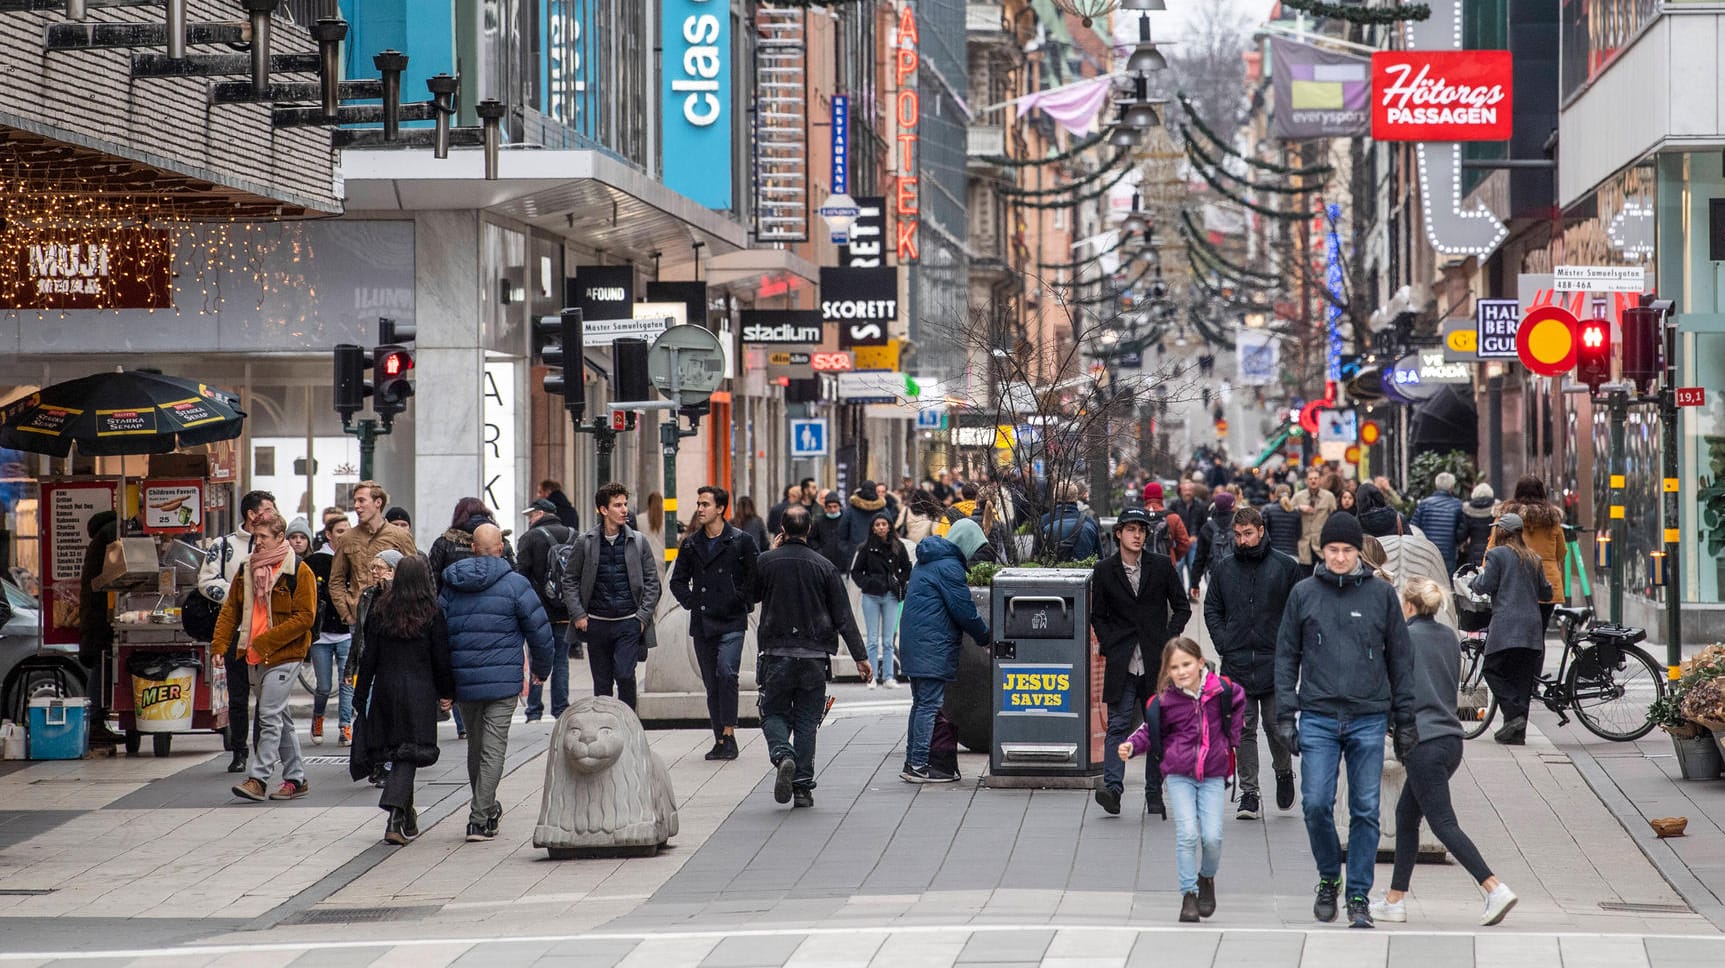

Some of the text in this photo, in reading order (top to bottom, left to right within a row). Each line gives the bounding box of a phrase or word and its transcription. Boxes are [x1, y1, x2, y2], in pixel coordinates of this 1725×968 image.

[671, 14, 720, 126] clas
[1382, 63, 1505, 109] Hötorgs
[1387, 107, 1497, 124] PASSAGEN
[897, 6, 919, 258] APOTEK
[835, 97, 844, 194] RESTAURANG
[29, 244, 108, 276] MUJI
[1587, 269, 1640, 279] Samuelsgatan
[586, 287, 625, 301] AFOUND
[821, 300, 897, 319] SCORETT
[613, 321, 663, 331] Samuelsgatan
[743, 323, 820, 341] stadium
[1484, 320, 1519, 334] BER
[1420, 365, 1467, 378] MODA
[1679, 391, 1702, 404] 19,1
[106, 418, 145, 426] STARKA
[110, 423, 142, 431] SENAP
[1002, 673, 1070, 690] JESUS
[141, 684, 182, 708] MER
[1011, 693, 1063, 706] SAVES
